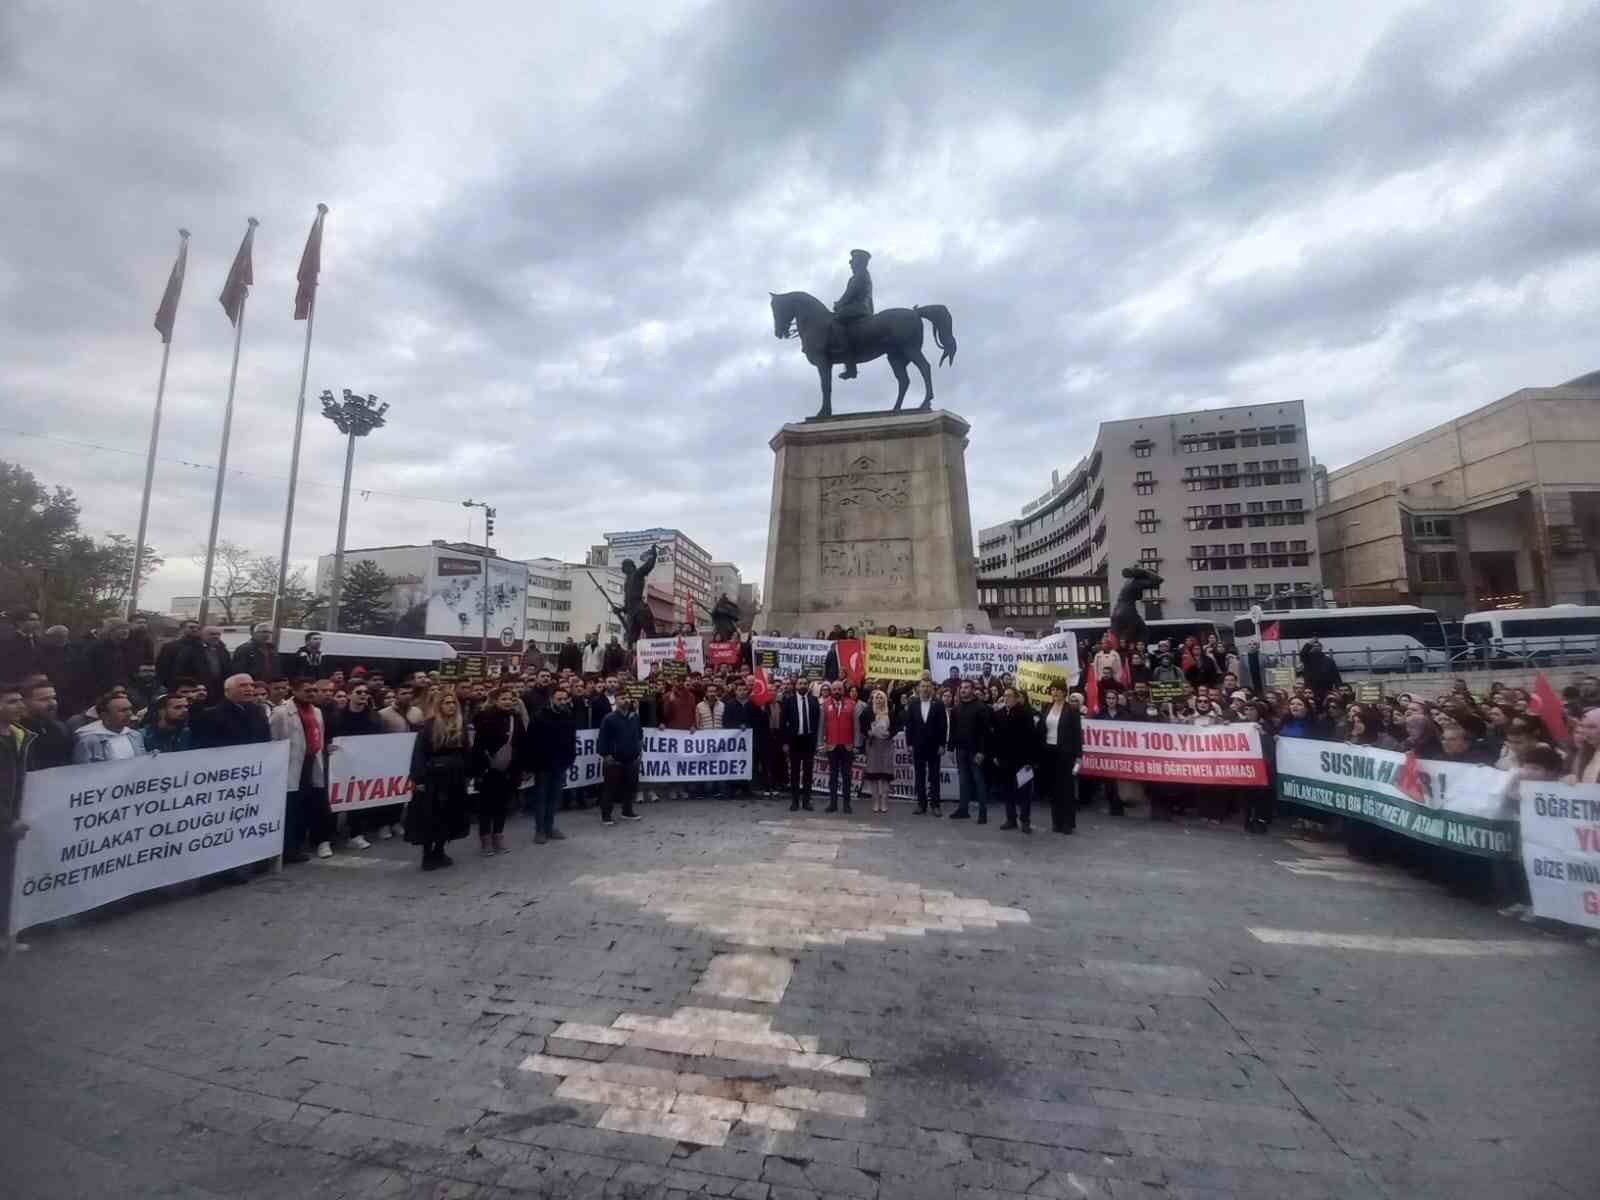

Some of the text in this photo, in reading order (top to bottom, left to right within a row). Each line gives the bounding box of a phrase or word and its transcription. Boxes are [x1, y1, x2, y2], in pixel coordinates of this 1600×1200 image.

[684, 736, 747, 754] BURADA
[70, 760, 263, 808] HEY ONBEŞLİ ONBEŞLİ
[677, 759, 747, 777] NEREDE?
[1320, 751, 1375, 781] SUSMA
[73, 784, 260, 832] TOKAT YOLLARI TAŞLI
[60, 804, 260, 863] MÜLAKAT OLDUĞU İÇİN
[22, 841, 183, 897] ÖĞRETMENLERİN
[188, 829, 235, 852] GÖZÜ
[1533, 856, 1567, 881] BİZE
